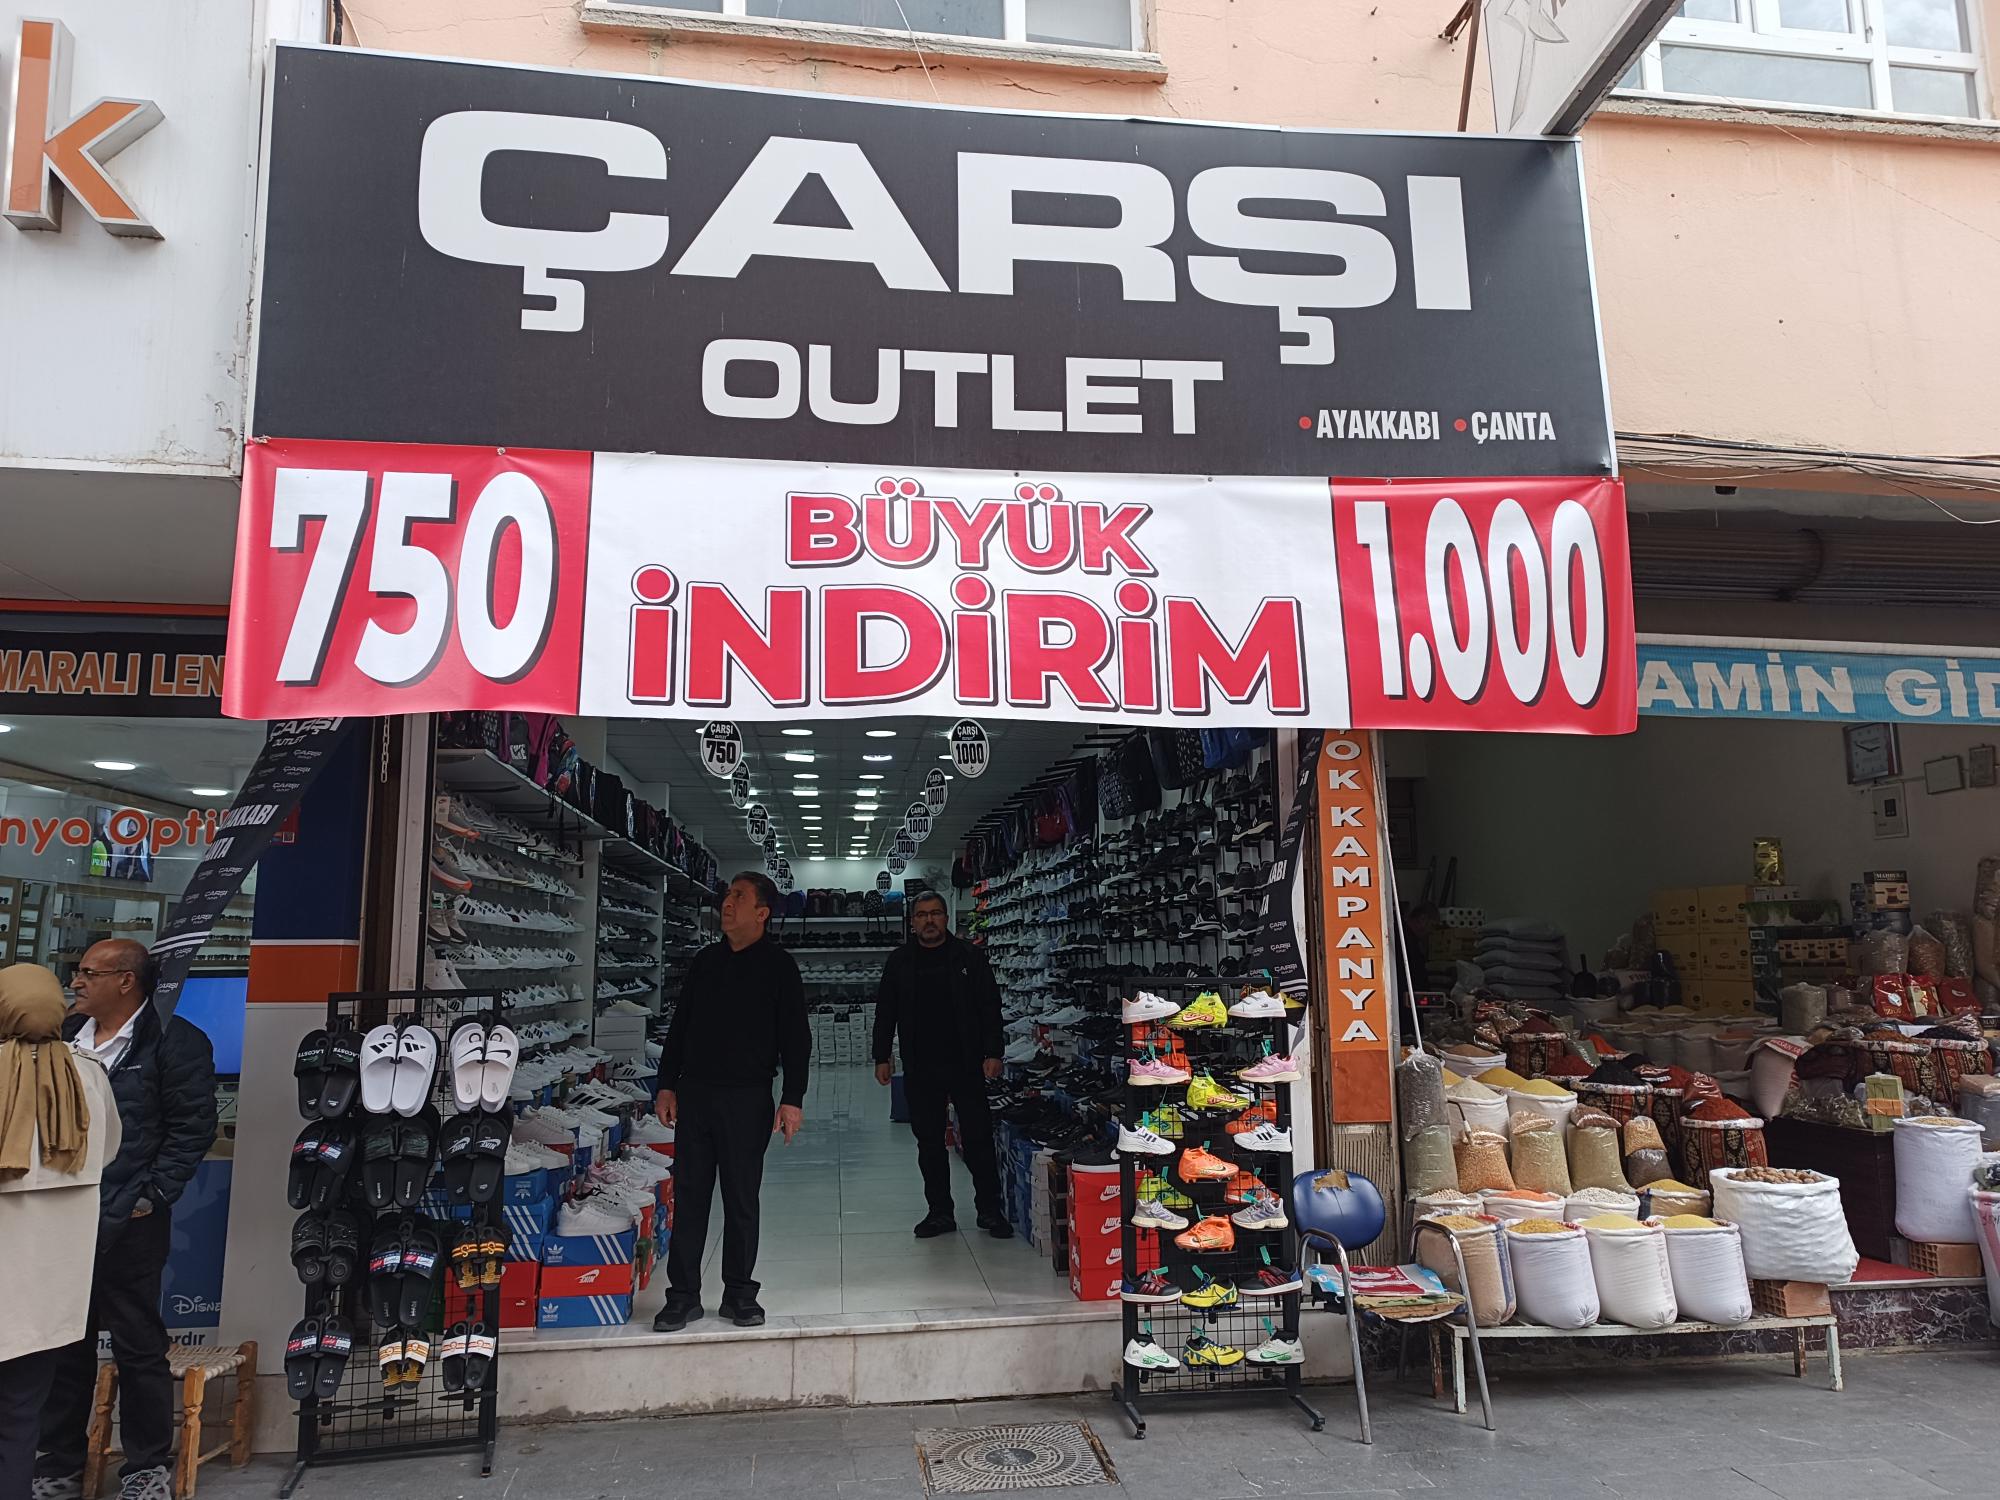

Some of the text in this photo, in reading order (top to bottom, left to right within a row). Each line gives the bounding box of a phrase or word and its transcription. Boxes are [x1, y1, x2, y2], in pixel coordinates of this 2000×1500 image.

[418, 110, 1472, 365] ÇARŞI
[702, 338, 1224, 436] OUTLET
[1316, 409, 1556, 445] AYAKKABI ÇANTA
[786, 477, 1159, 578] BÜYÜK
[269, 467, 560, 689] 750
[1354, 497, 1606, 706] 1.000
[626, 564, 1309, 717] İNDİRİM
[710, 723, 734, 737] ÇARŞI
[957, 726, 979, 739] ÇARŞI
[706, 740, 737, 765] 750
[956, 743, 985, 765] 1000
[1325, 728, 1363, 791] OK
[733, 779, 749, 799] 750
[927, 787, 945, 806] 1000
[108, 807, 230, 855] Opti
[749, 820, 766, 835] 750
[908, 819, 929, 834] 1000
[897, 841, 916, 854] 1000
[1330, 805, 1380, 1042] KAMPANYA
